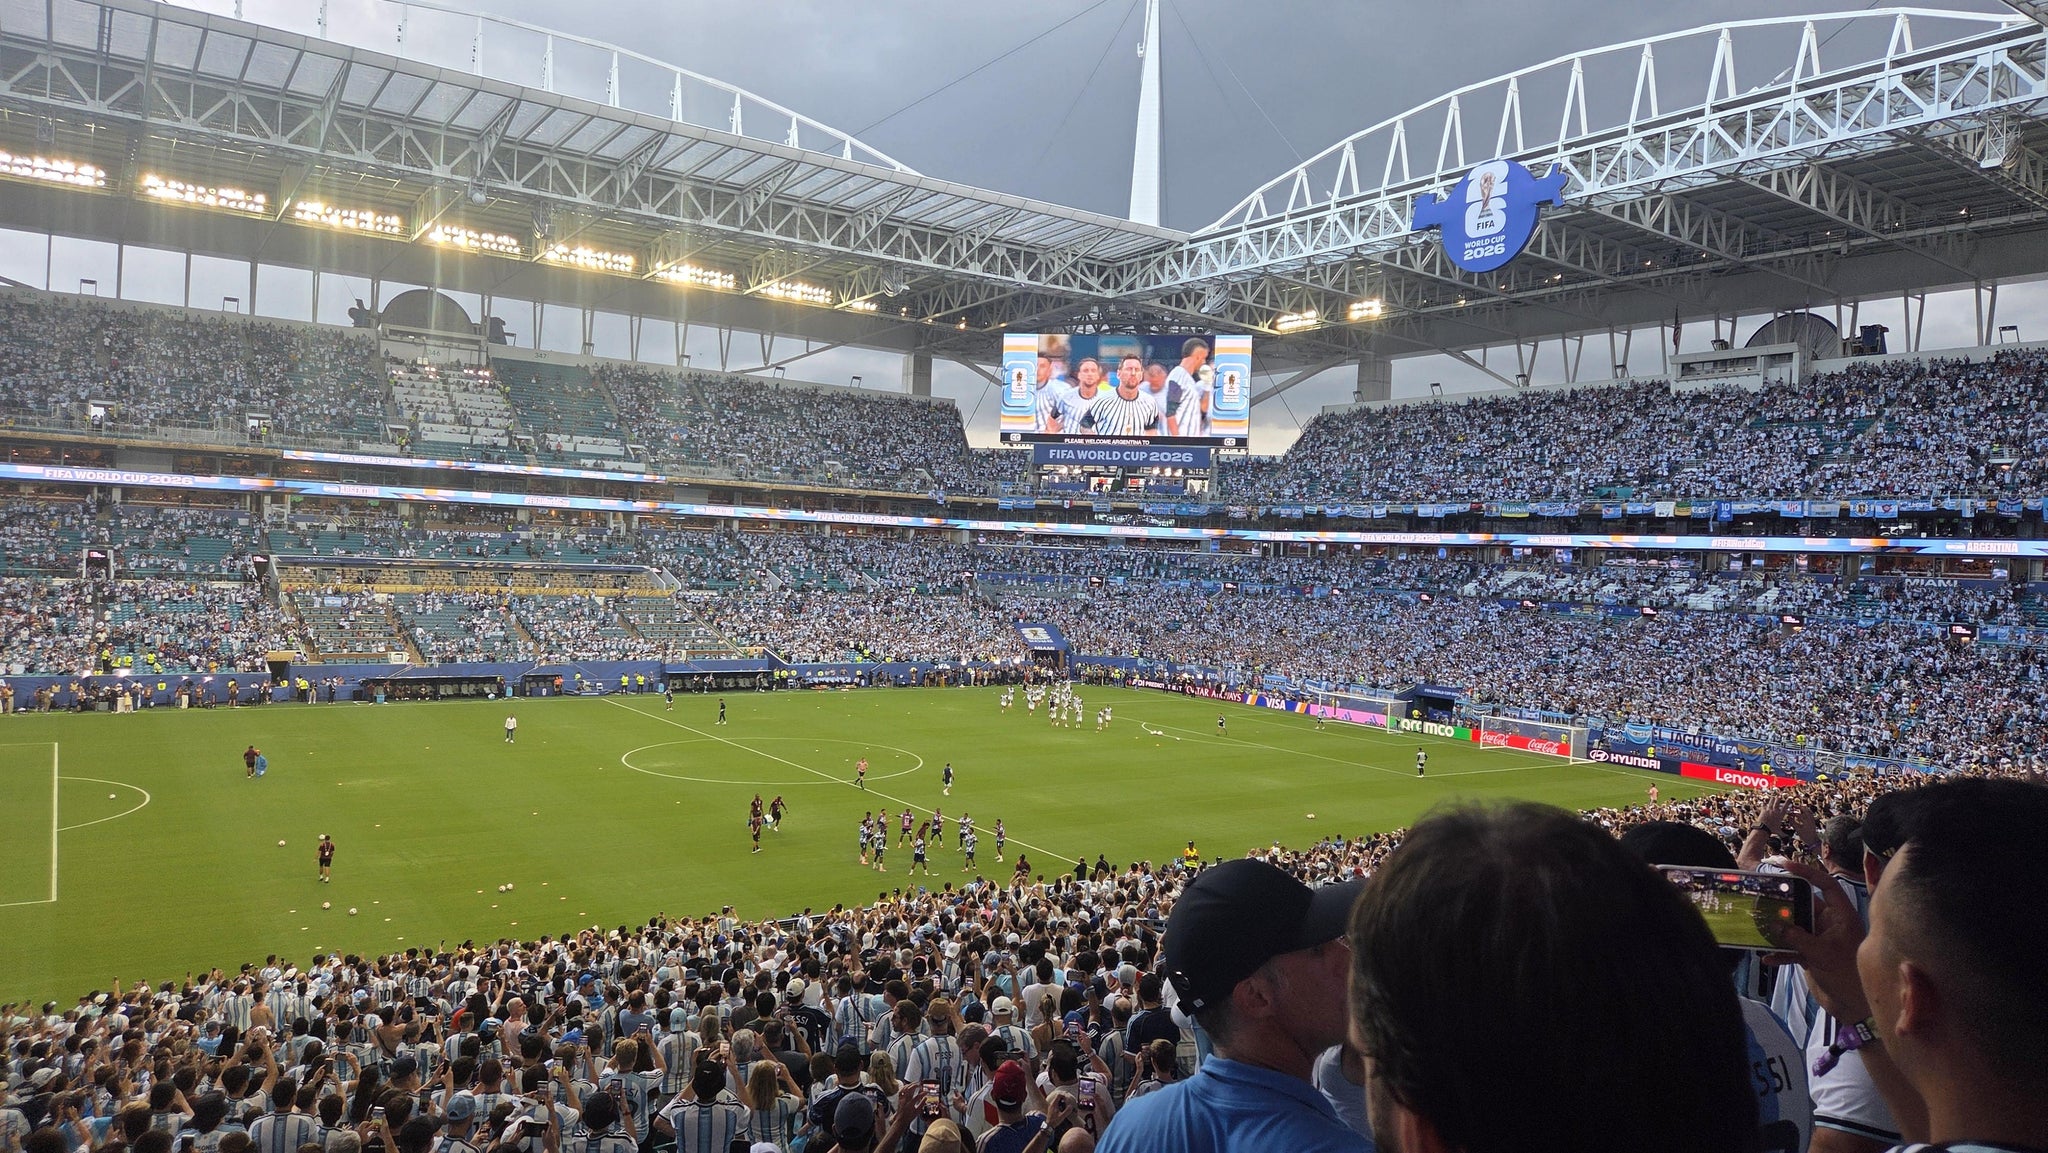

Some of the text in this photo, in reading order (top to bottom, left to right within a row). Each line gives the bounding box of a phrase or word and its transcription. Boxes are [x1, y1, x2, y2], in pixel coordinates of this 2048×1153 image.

[1476, 220, 1495, 231] FIFA
[1464, 235, 1506, 249] WORLD CUP
[1463, 243, 1506, 261] 2026
[1049, 449, 1194, 463] FIFA WORLD CUP 2026
[45, 469, 194, 485] FIFA WORLD CUP 2026
[1721, 502, 1730, 511] 10
[1360, 534, 1376, 542] FIFA
[1376, 534, 1400, 542] WORLD
[1966, 542, 2018, 553] ARGENTINA
[1905, 578, 1958, 588] MIAMI
[1265, 697, 1286, 711] VISA
[1401, 719, 1455, 738] aramco
[1528, 739, 1559, 754] Coca-Cola
[1715, 743, 1738, 755] FIFA
[1610, 753, 1661, 770] HYUNDAI
[1715, 768, 1769, 788] Lenovo
[379, 989, 391, 1002] 10
